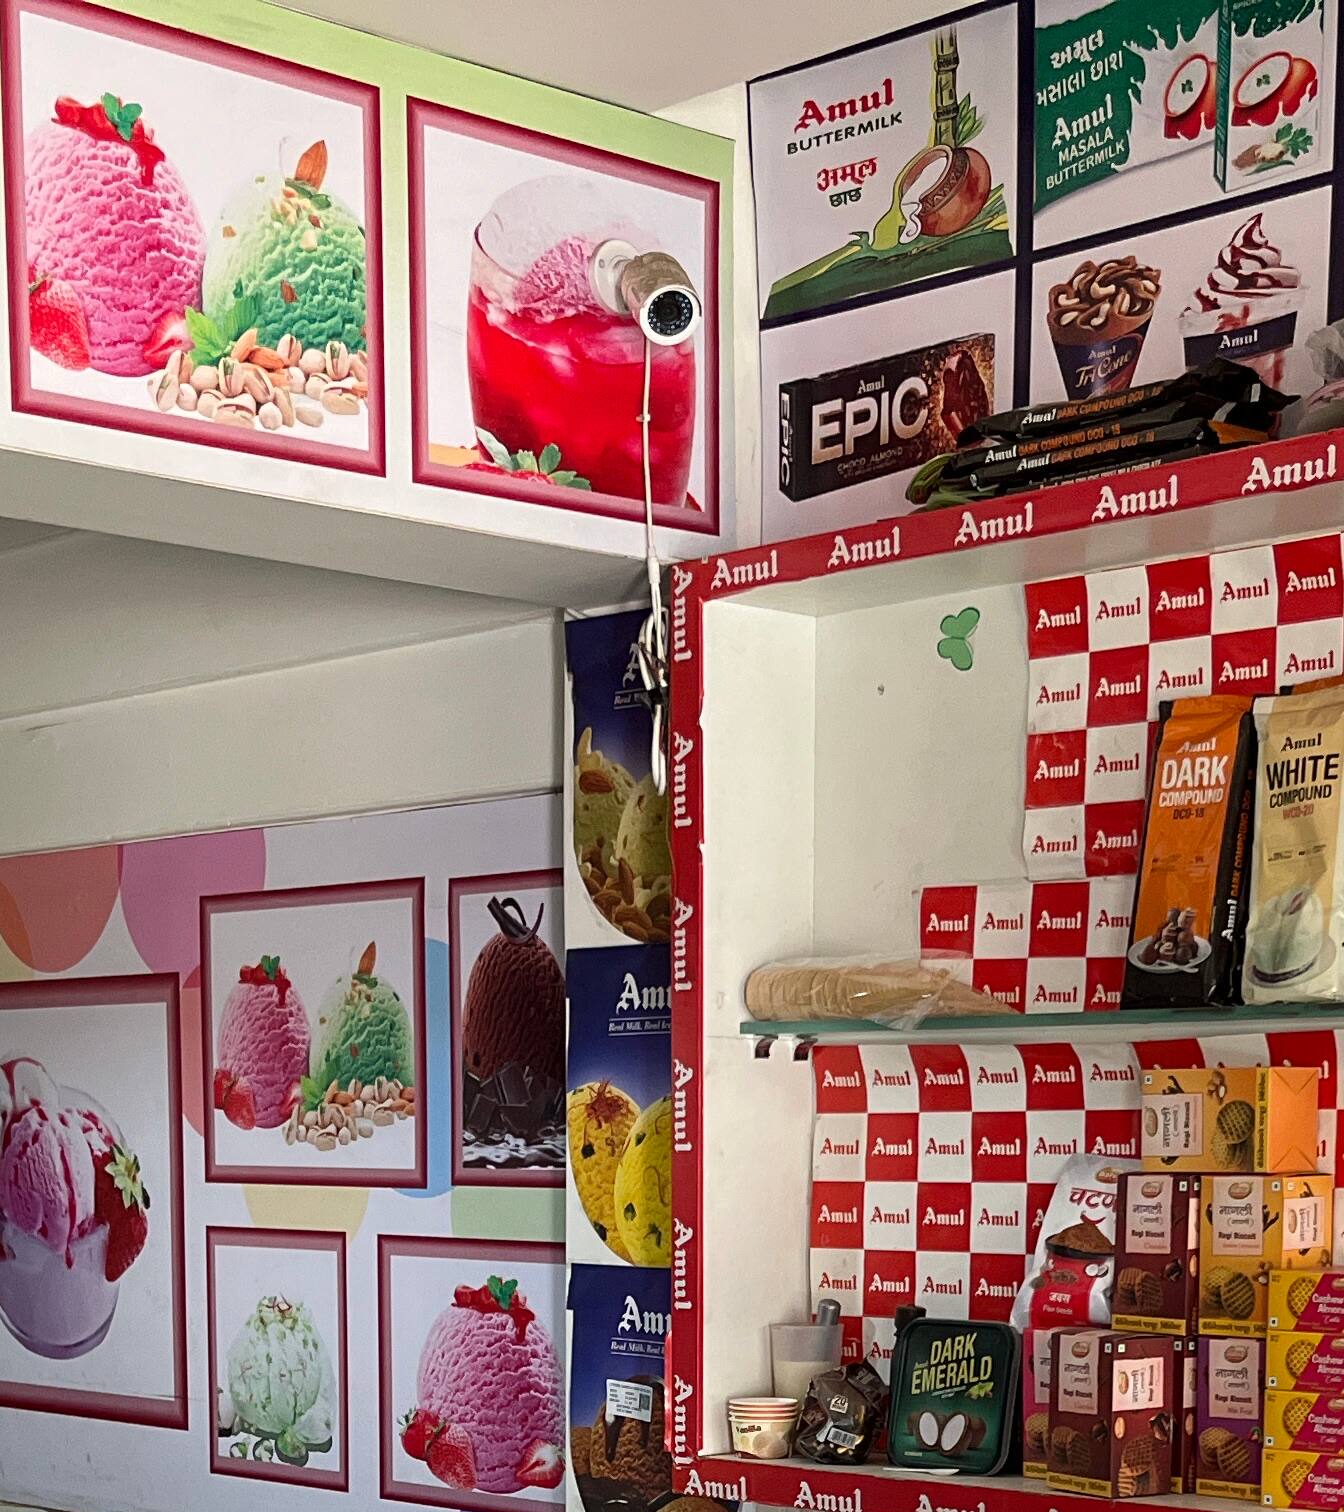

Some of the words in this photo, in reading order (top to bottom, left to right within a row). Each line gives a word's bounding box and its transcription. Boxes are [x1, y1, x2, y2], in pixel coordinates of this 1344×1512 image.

[1050, 29, 1105, 69] અમૂલ
[793, 77, 896, 133] Amul
[1035, 70, 1086, 107] મસાલા
[786, 111, 904, 155] BUTTERMILK
[1051, 93, 1114, 151] Amul
[1058, 126, 1114, 166] MASALA
[1046, 140, 1126, 190] BUTTERMILK
[828, 186, 863, 209] छाछ
[1088, 346, 1117, 361] Amul
[1217, 329, 1259, 350] Amul
[856, 375, 885, 395] Amul
[810, 376, 930, 465] EPIC
[1021, 408, 1056, 425] Amul
[780, 392, 791, 487] EPIC
[984, 445, 1018, 464] Amul
[1016, 453, 1051, 472] Amul
[711, 551, 778, 590] Amul
[1094, 598, 1143, 621] Amul
[1176, 736, 1217, 756] Amul
[1280, 732, 1323, 753] Amul
[1160, 755, 1227, 791] DARK
[1265, 752, 1340, 792] WHITE
[1158, 788, 1224, 808] COMPOUND
[1269, 784, 1332, 809] COMPOUND
[1221, 898, 1238, 943] Amul
[923, 1065, 965, 1087] Amul
[1311, 1293, 1344, 1304] Cashew
[929, 1332, 978, 1365] DARK
[910, 1355, 993, 1397] EMERALD
[684, 1468, 747, 1502] Amul
[1307, 1473, 1341, 1485] Cashew
